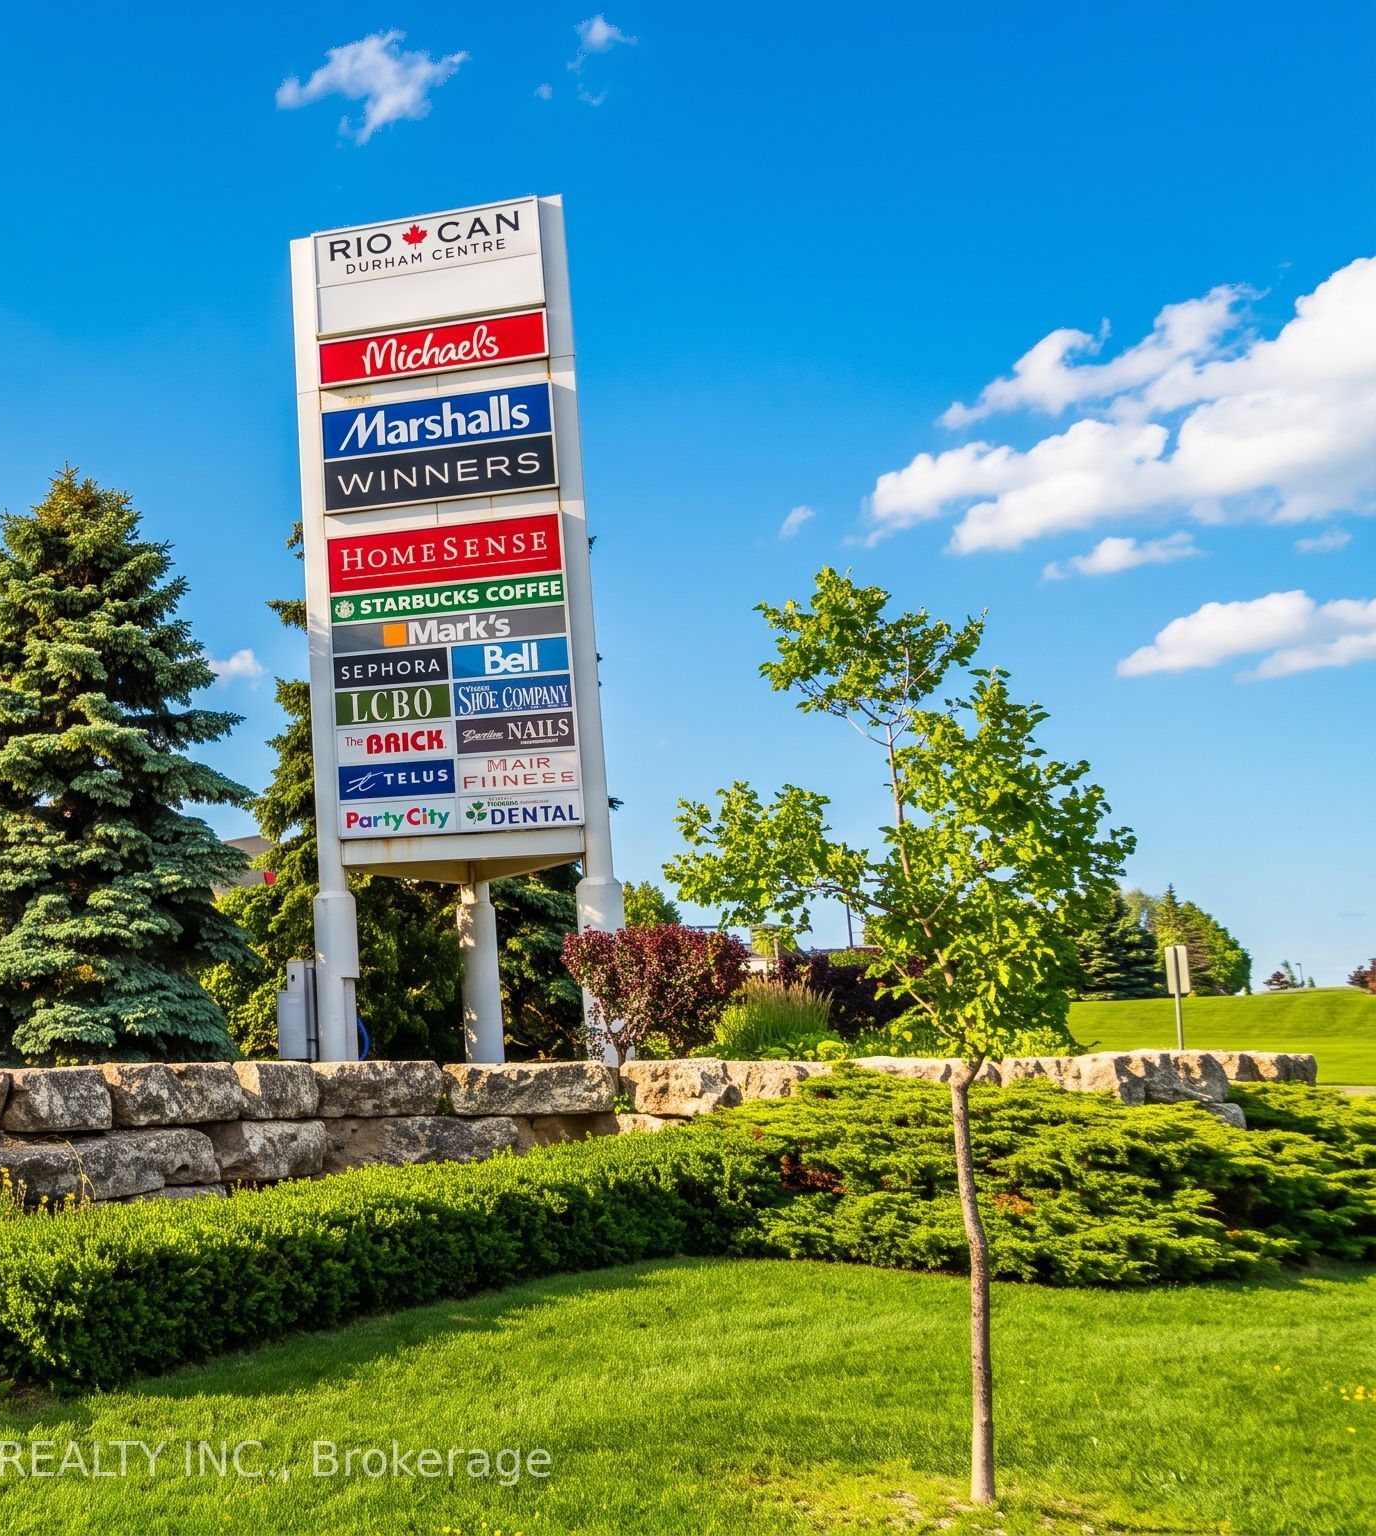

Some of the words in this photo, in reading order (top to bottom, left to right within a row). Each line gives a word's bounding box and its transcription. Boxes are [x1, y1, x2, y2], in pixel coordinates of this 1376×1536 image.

[328, 233, 392, 262] RIO
[437, 210, 520, 243] CAN
[346, 252, 423, 275] DURHAM
[432, 238, 506, 261] CENTRE
[362, 325, 500, 376] Michaels
[339, 394, 530, 451] Marshalls
[337, 452, 541, 496] WINNERS
[360, 587, 480, 615] STARBUCKS
[486, 580, 562, 601] COFFEE
[408, 614, 511, 645] Mark's
[341, 658, 441, 680] SEPHORA
[483, 642, 539, 675] Bell
[350, 687, 433, 723] LCBO
[458, 686, 499, 715] SHOE
[502, 685, 568, 709] COMPANY
[345, 736, 363, 747] The
[507, 718, 570, 740] NAILS
[383, 769, 449, 785] TELUS
[490, 804, 580, 825] DENTAL
